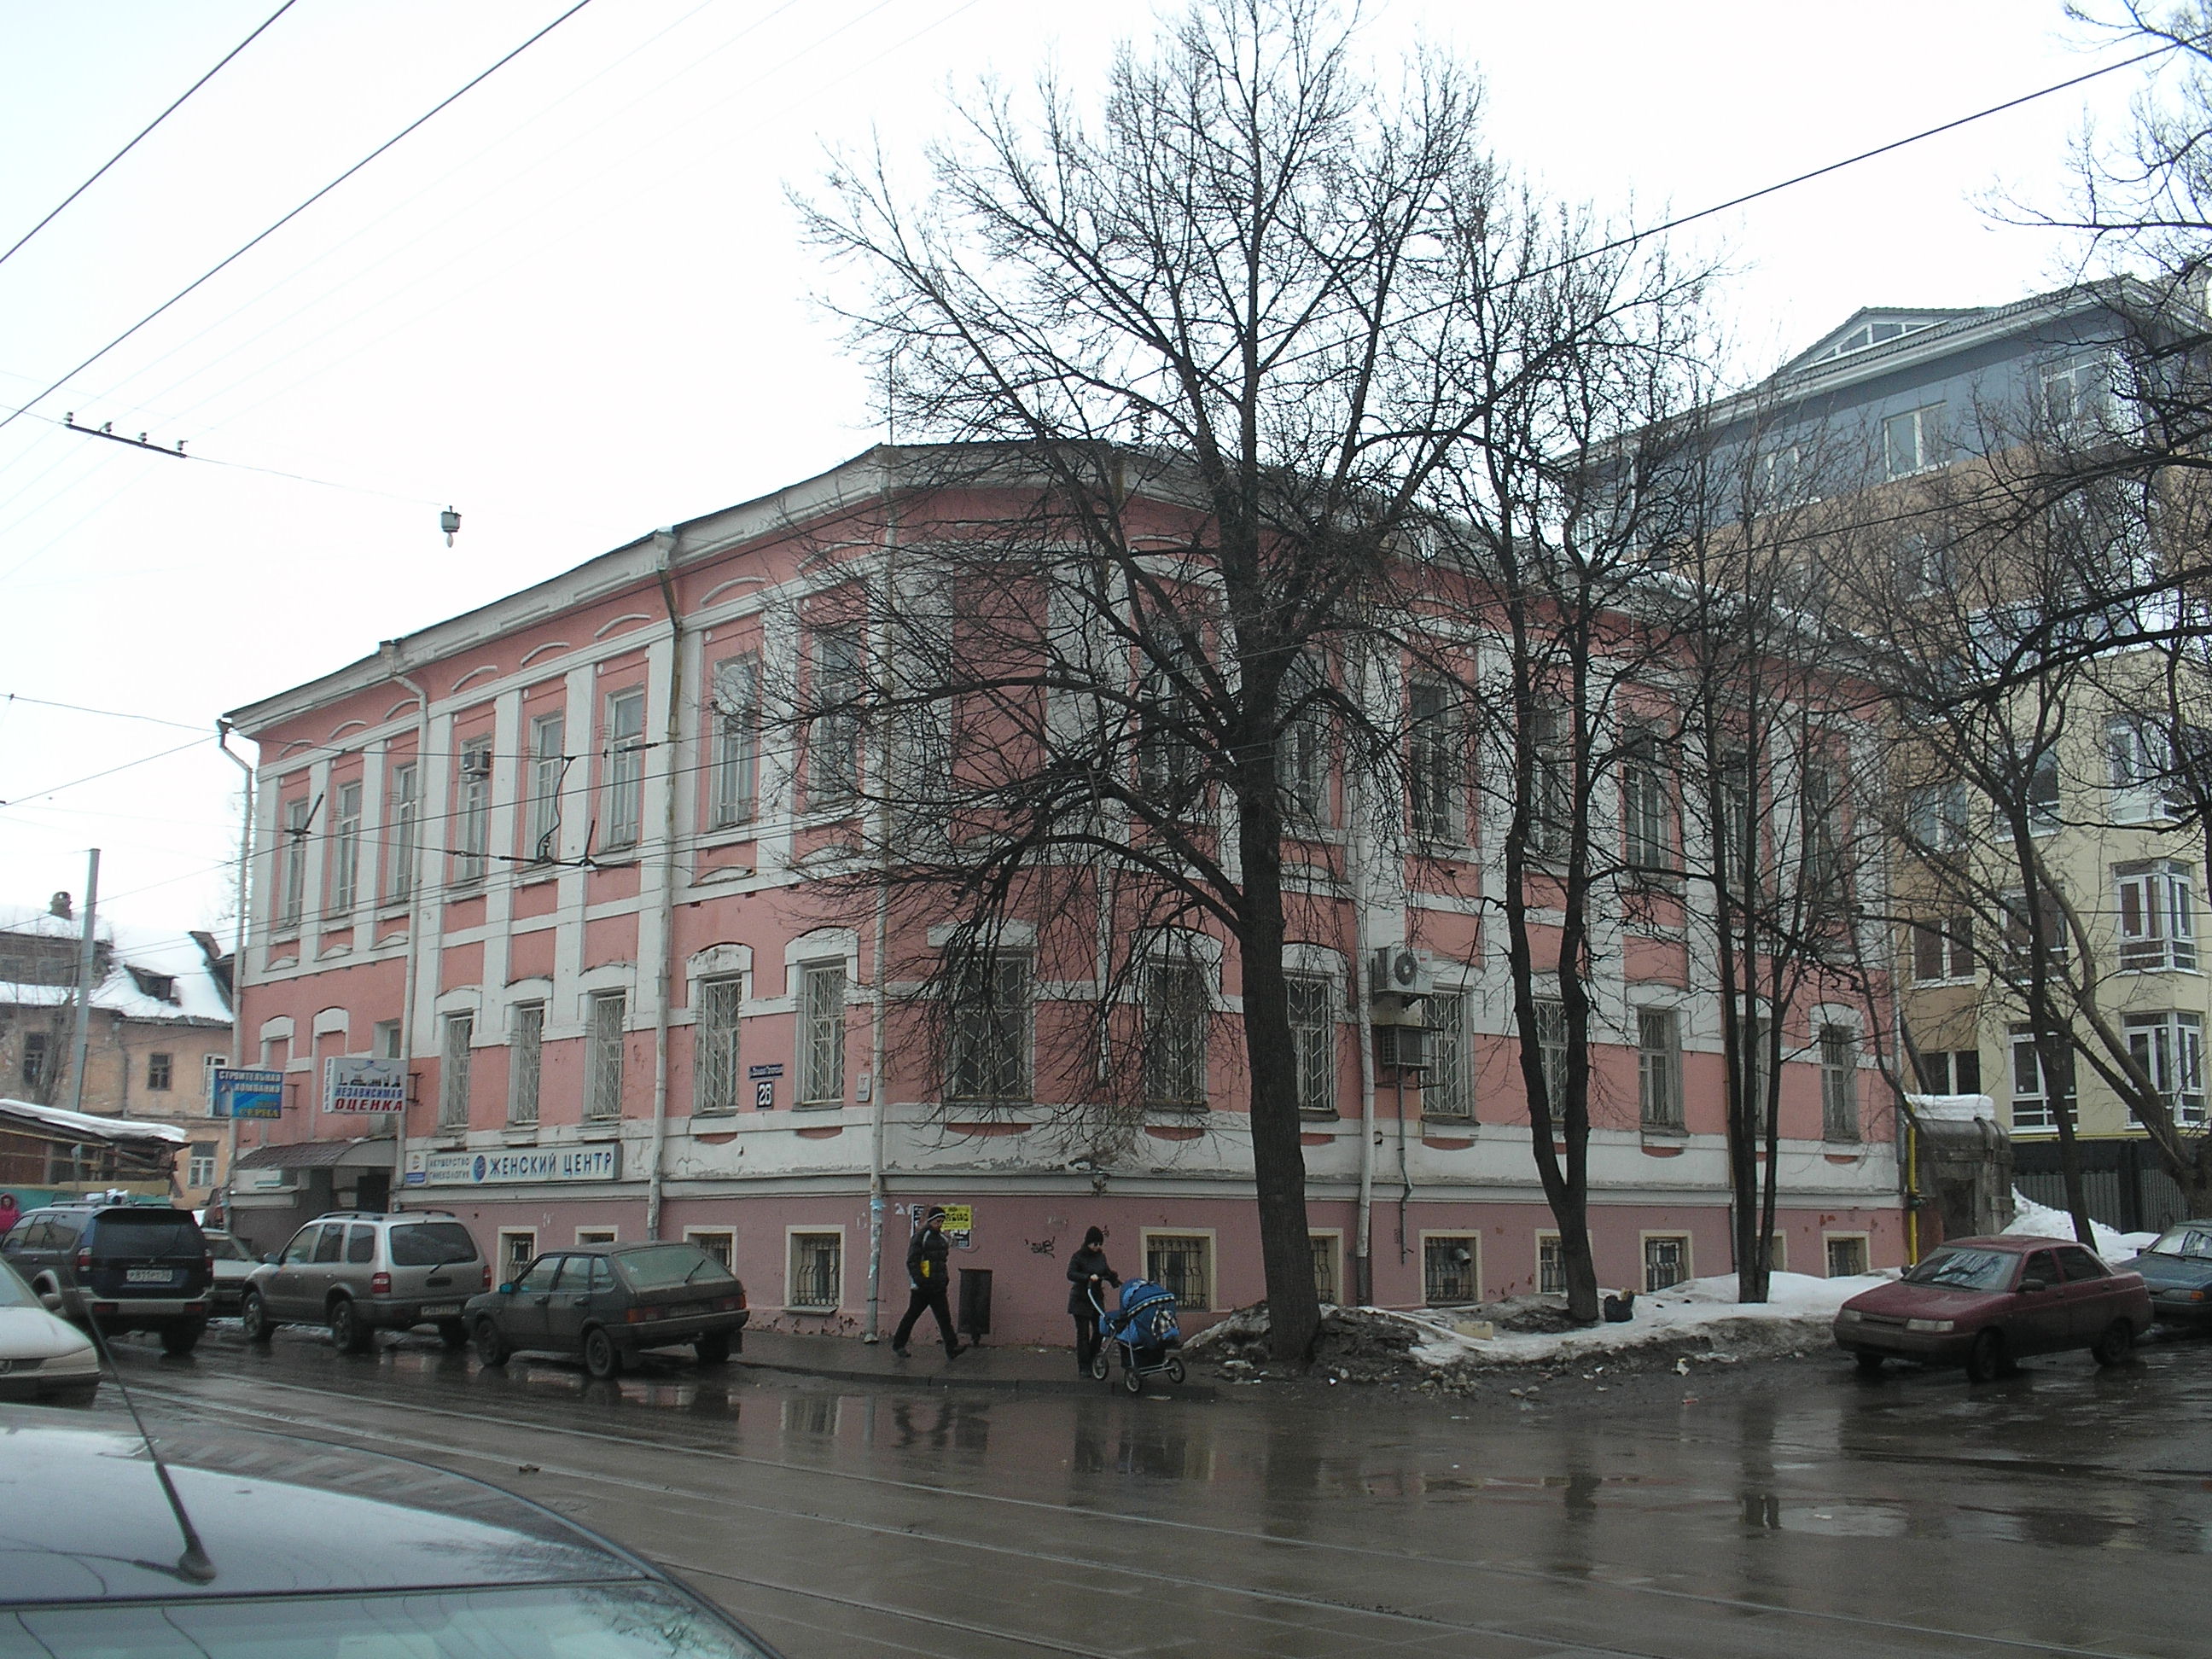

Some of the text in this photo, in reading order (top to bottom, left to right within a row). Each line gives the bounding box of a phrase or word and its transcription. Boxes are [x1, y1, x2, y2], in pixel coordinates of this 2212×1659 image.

[218, 1070, 281, 1082] СТРОИТЕЛЬНАЯ
[335, 1087, 403, 1098] НЕЗАВИСИМАЯ
[758, 1084, 771, 1105] 28
[335, 1098, 403, 1111] ОЦЕНКА
[490, 1152, 612, 1175] ЖЕНСКИЙ ЦЕНТР
